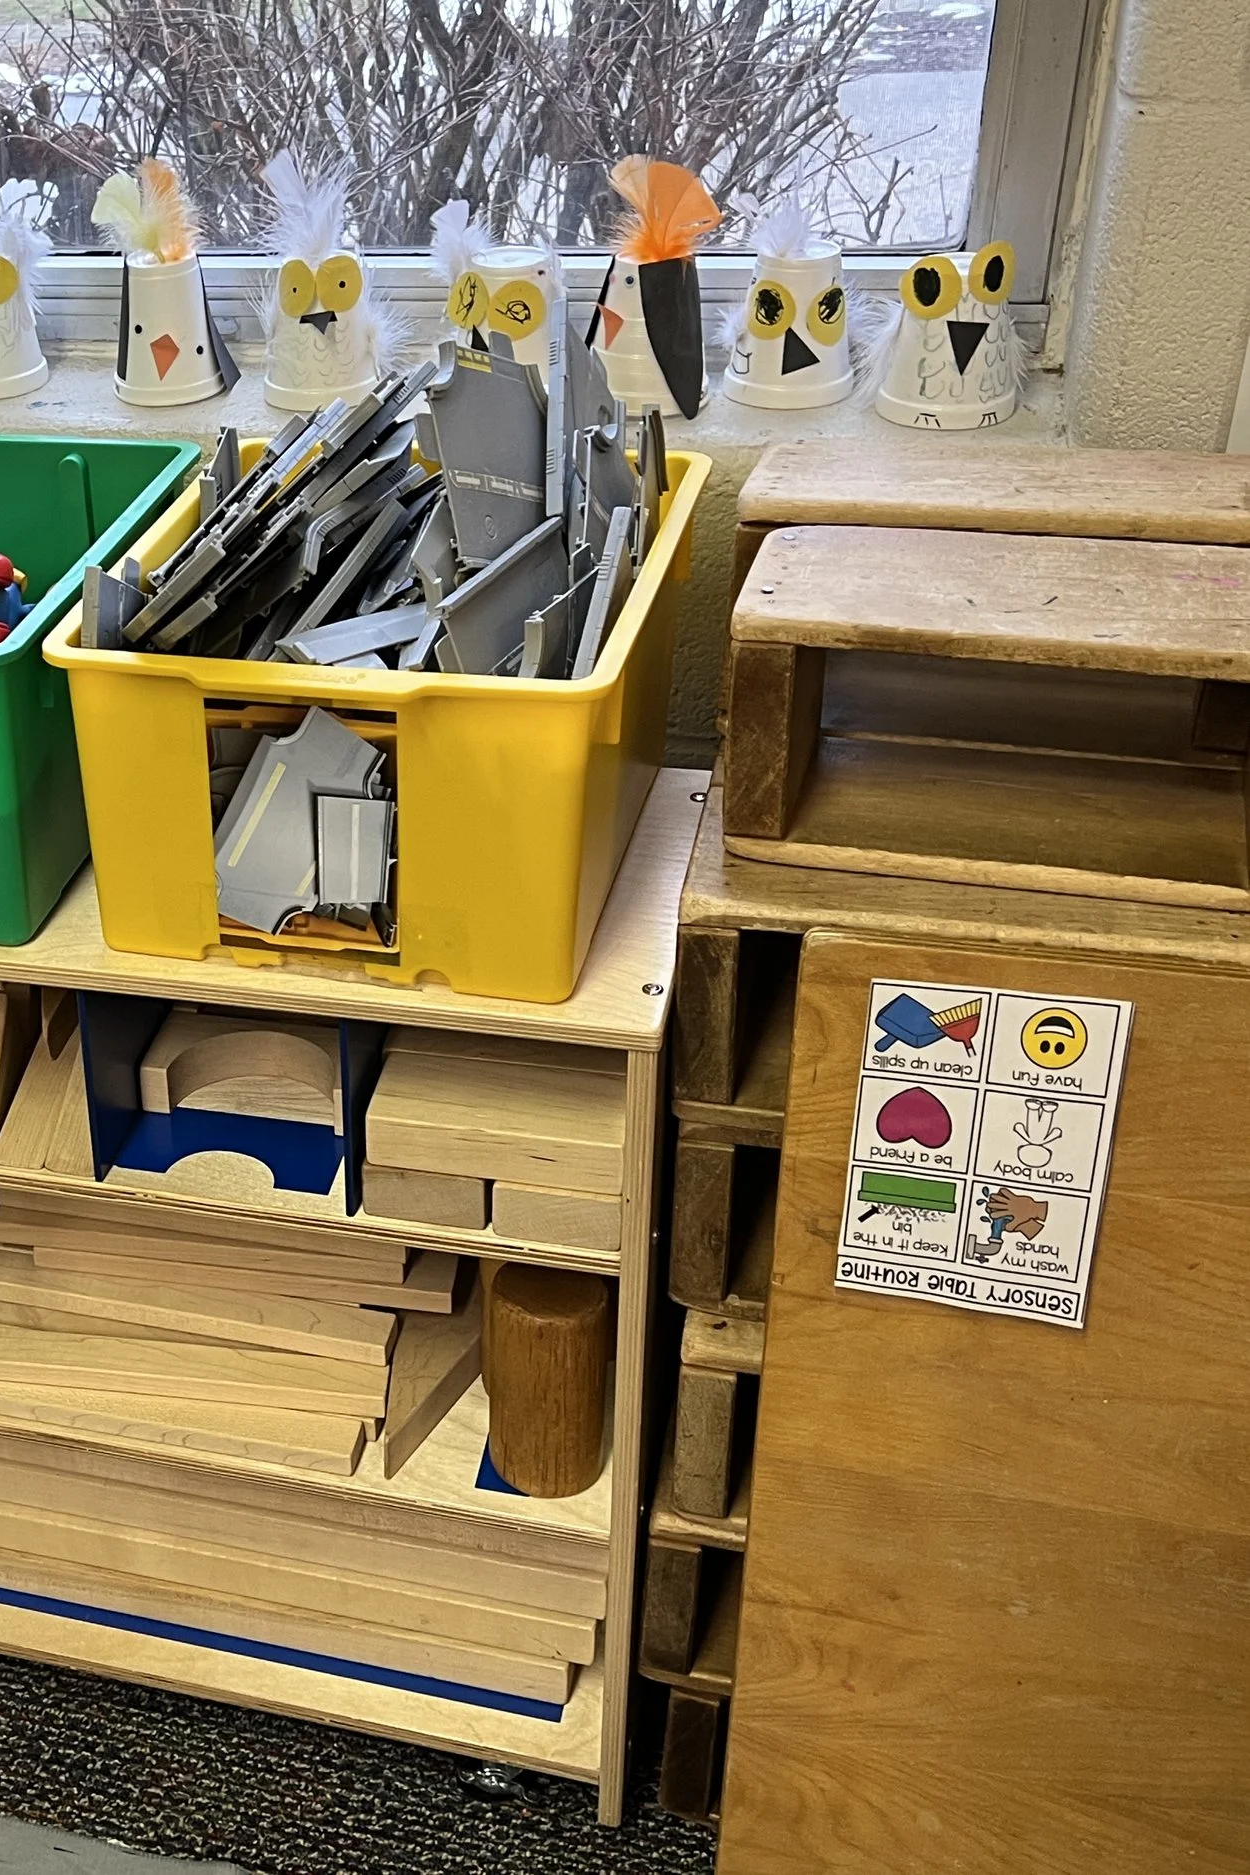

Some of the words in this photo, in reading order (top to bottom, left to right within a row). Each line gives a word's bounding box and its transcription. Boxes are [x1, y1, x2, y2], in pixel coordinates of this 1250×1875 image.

[872, 1055, 906, 1067] spills
[910, 1058, 929, 1071] up
[934, 1063, 973, 1077] clean
[1012, 1070, 1040, 1086] fun
[1045, 1075, 1083, 1091] have
[870, 1146, 915, 1163] friend
[920, 1154, 929, 1163] a
[935, 1155, 952, 1168] be
[993, 1160, 1032, 1180] body
[1037, 1171, 1074, 1184] calm
[892, 1221, 912, 1234] bin
[853, 1232, 878, 1244] the
[882, 1237, 894, 1246] in
[899, 1239, 909, 1249] it
[1015, 1241, 1059, 1257] hands
[1001, 1255, 1027, 1267] my
[1030, 1259, 1069, 1274] wash
[841, 1262, 919, 1287] Routine
[927, 1275, 977, 1299] Table
[986, 1285, 1074, 1315] Sensory
